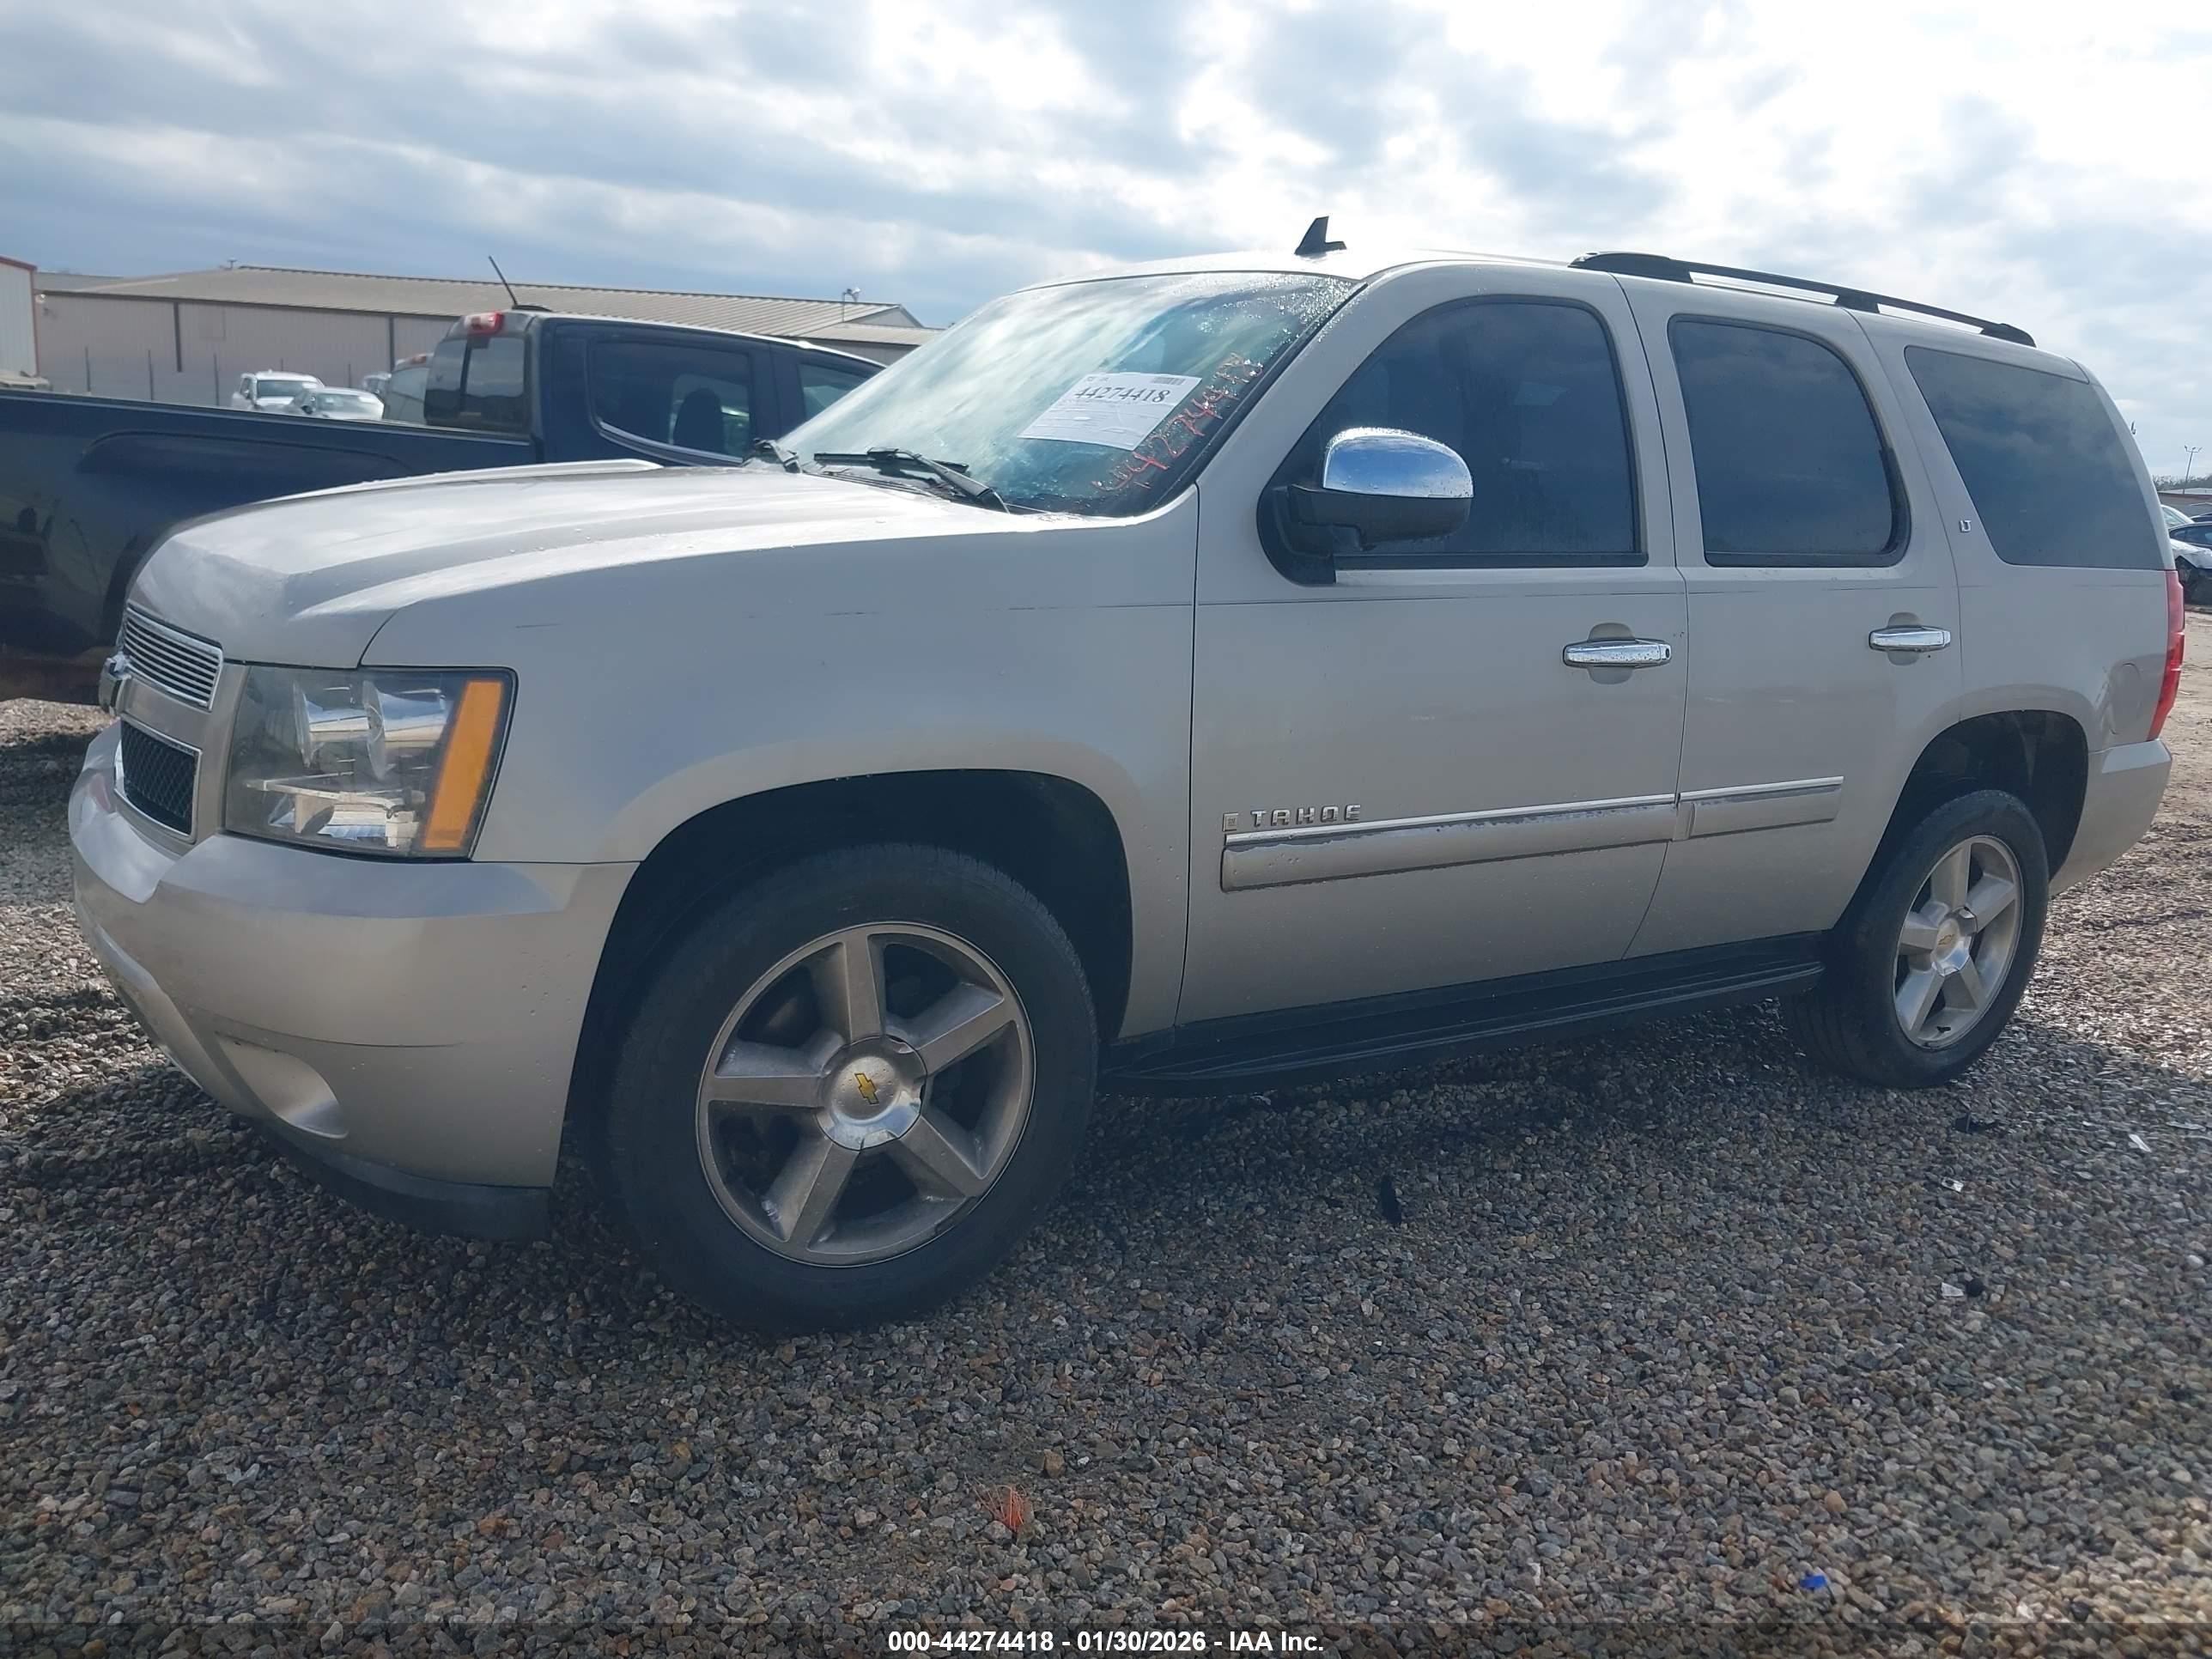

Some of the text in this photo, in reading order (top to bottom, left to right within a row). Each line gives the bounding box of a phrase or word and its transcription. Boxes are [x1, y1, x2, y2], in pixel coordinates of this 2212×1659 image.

[1074, 386, 1170, 403] 44274418
[1959, 520, 1972, 532] LT
[1250, 804, 1361, 827] TAHOE
